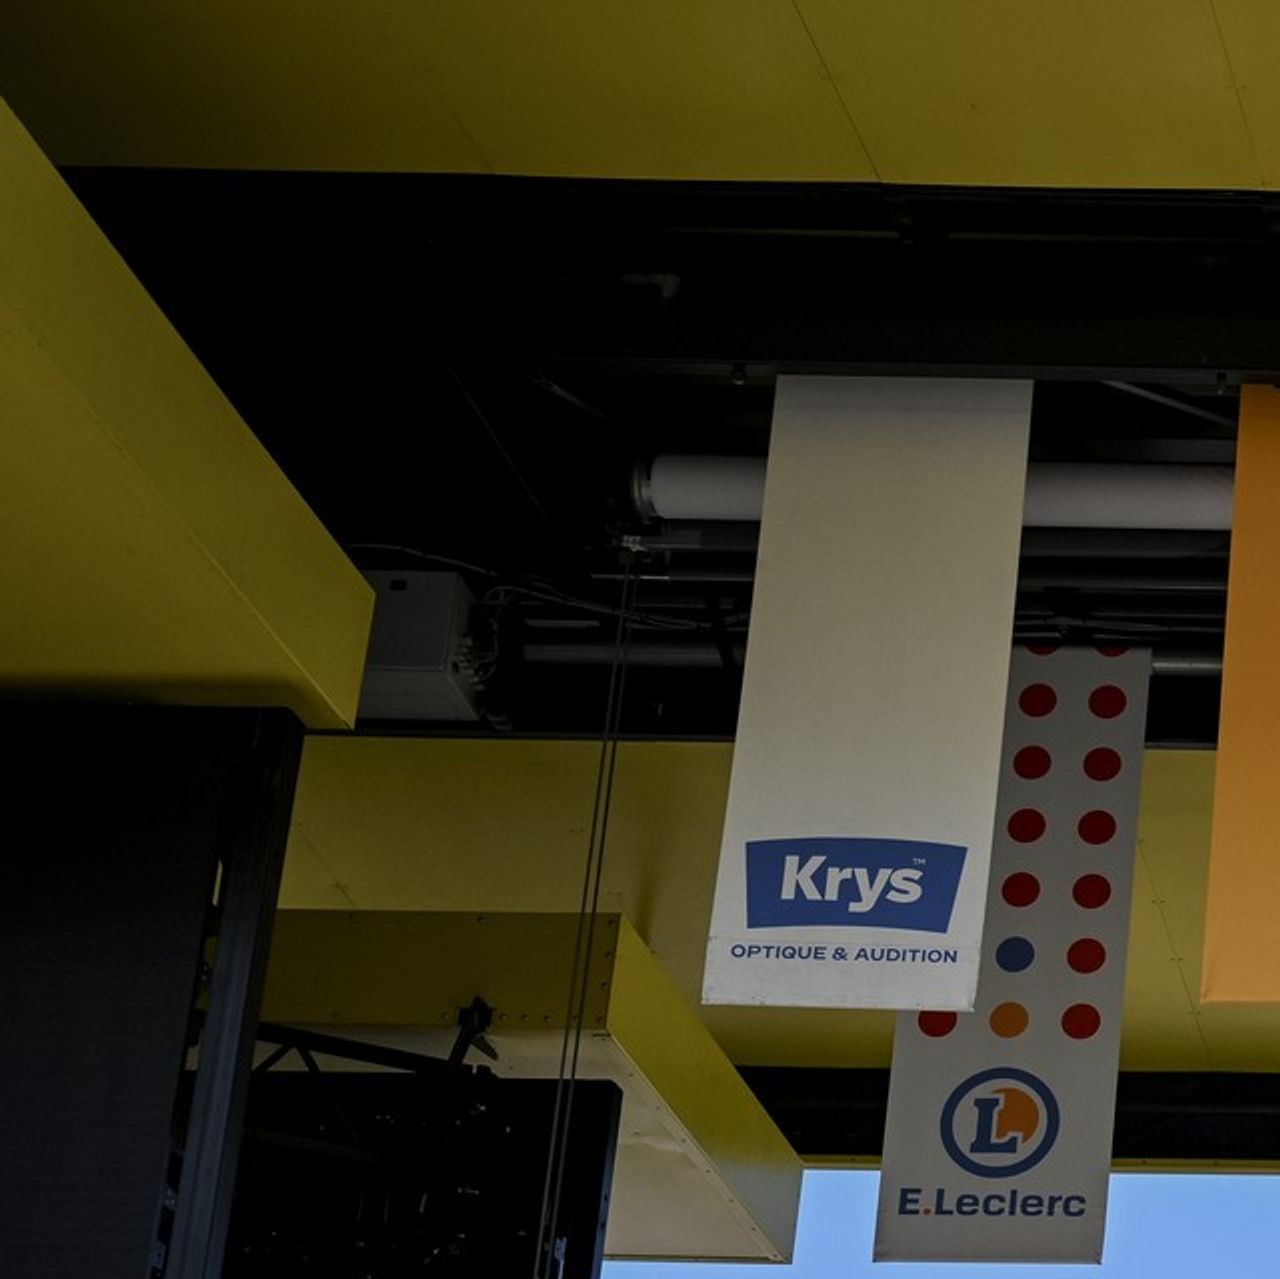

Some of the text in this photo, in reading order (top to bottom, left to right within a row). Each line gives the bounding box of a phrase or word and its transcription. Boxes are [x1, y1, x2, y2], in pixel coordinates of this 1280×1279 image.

[781, 856, 923, 913] Krys
[731, 944, 957, 963] OPTIQUE & AUDITION
[898, 1188, 1086, 1217] E.Leclerc
